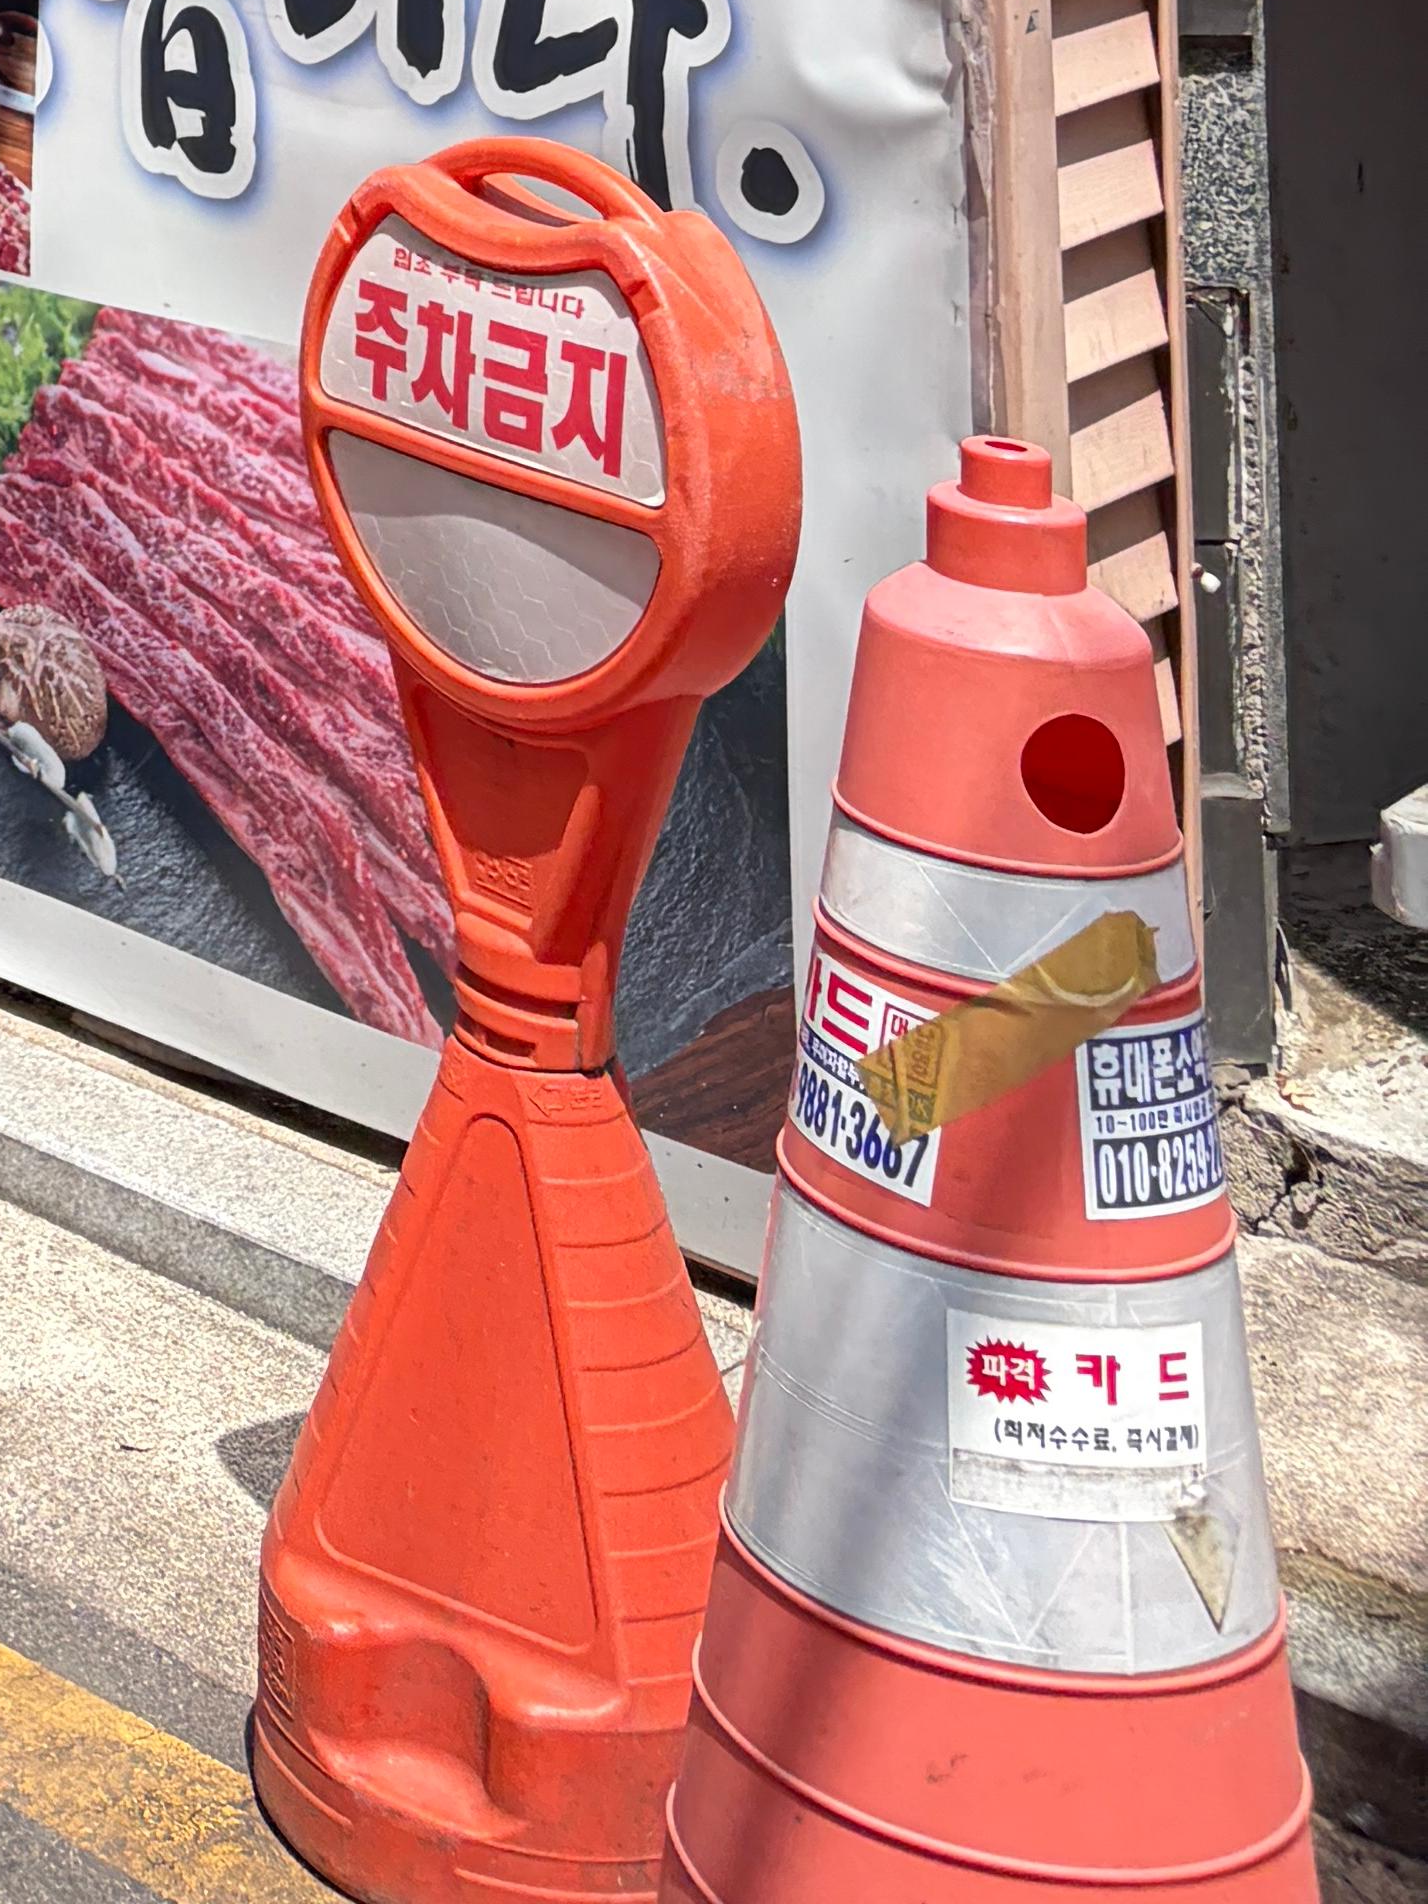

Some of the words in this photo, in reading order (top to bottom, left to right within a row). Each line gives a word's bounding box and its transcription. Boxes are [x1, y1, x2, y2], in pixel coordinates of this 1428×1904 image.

[490, 274, 586, 320] 드립니다
[354, 278, 628, 480] 주차금지
[981, 1354, 1036, 1391] 파격
